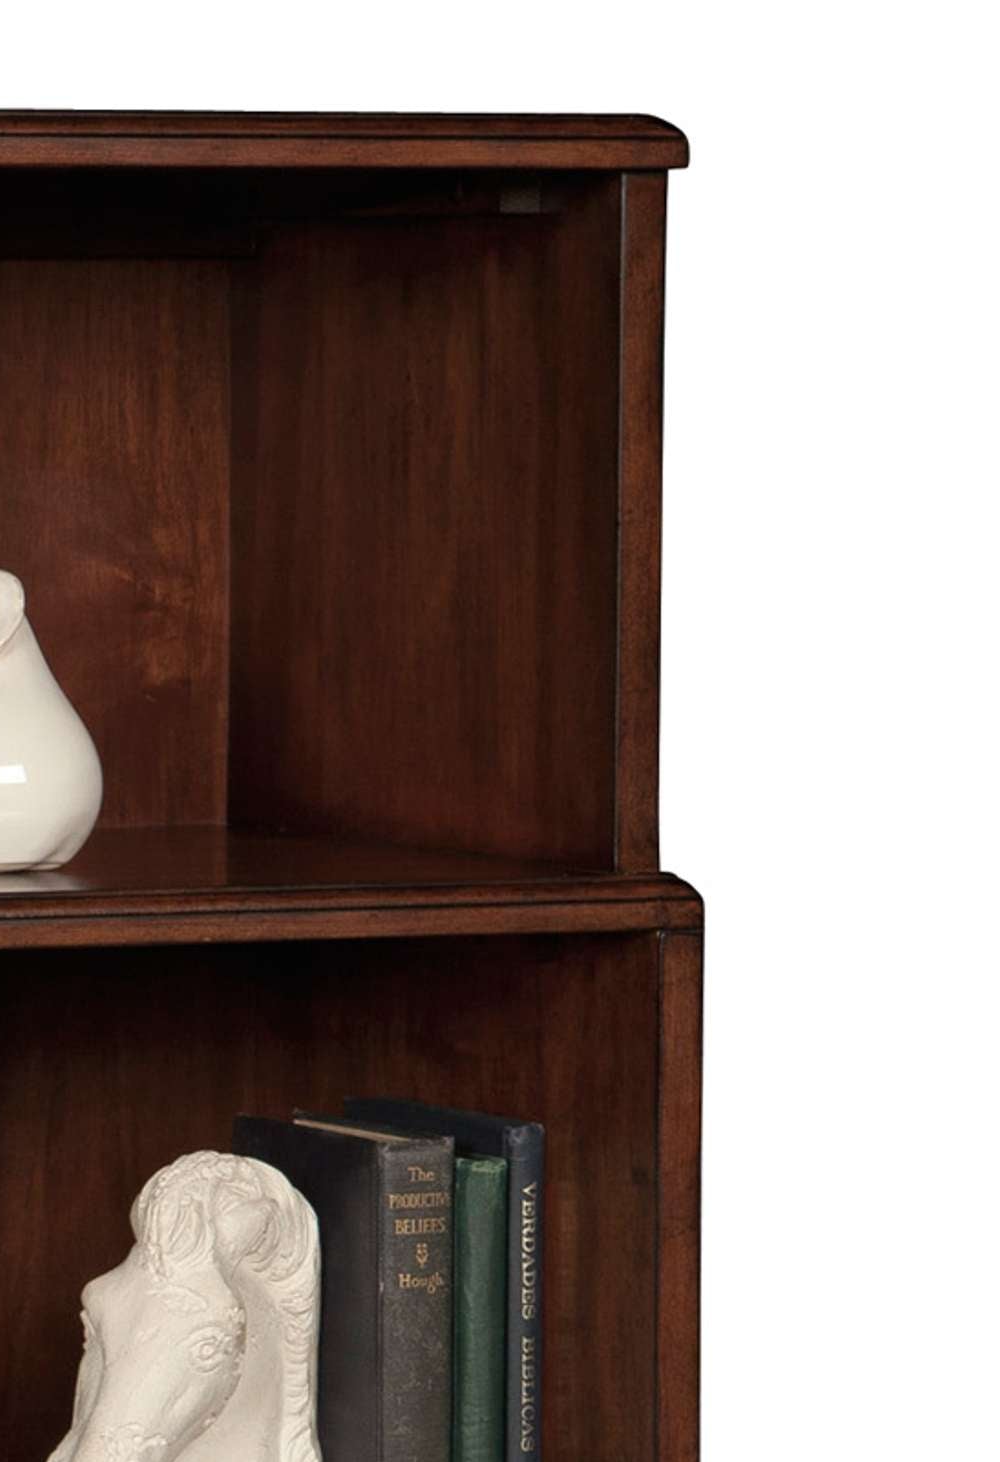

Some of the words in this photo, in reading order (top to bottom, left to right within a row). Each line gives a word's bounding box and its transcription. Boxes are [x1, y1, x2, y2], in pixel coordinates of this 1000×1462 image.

[407, 1166, 435, 1182] The
[395, 1217, 447, 1235] BELIEFS
[520, 1182, 537, 1320] VERDADES
[520, 1336, 535, 1452] BIBLICAS
